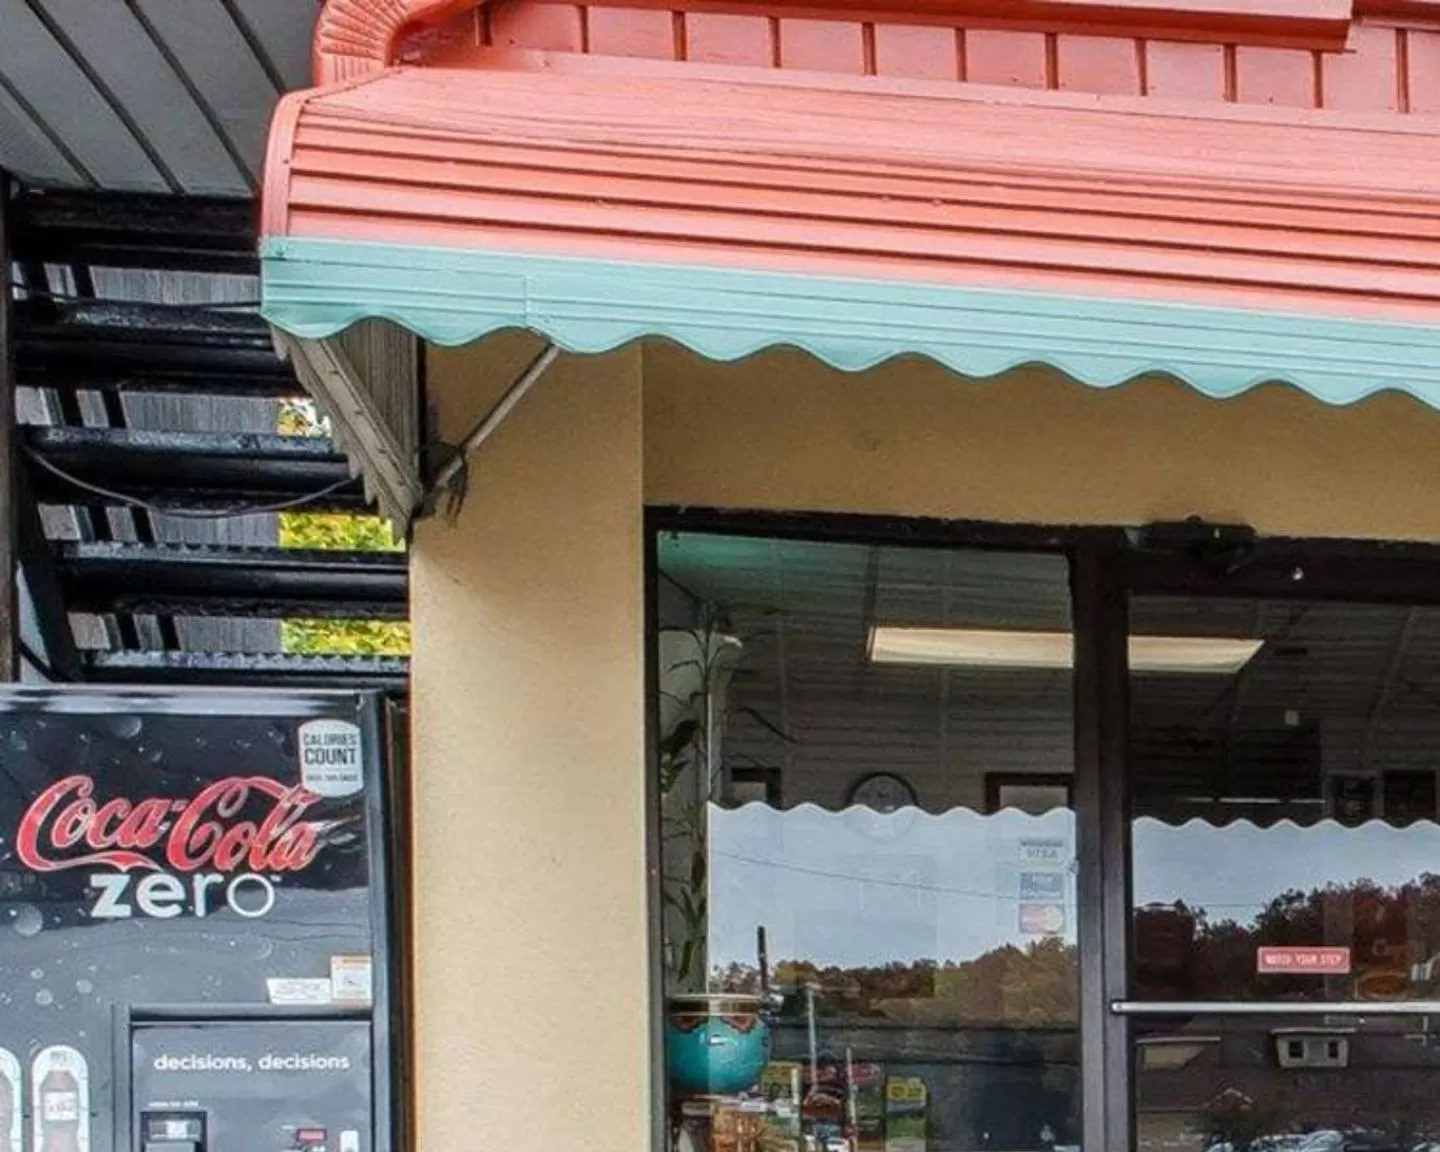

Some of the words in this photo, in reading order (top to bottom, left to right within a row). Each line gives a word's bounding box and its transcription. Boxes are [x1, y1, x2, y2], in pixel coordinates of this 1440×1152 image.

[304, 748, 357, 765] COUNT
[16, 774, 322, 872] Coca-Cola
[90, 873, 275, 918] zero
[153, 1054, 253, 1072] decisions,
[258, 1054, 349, 1069] decisions
